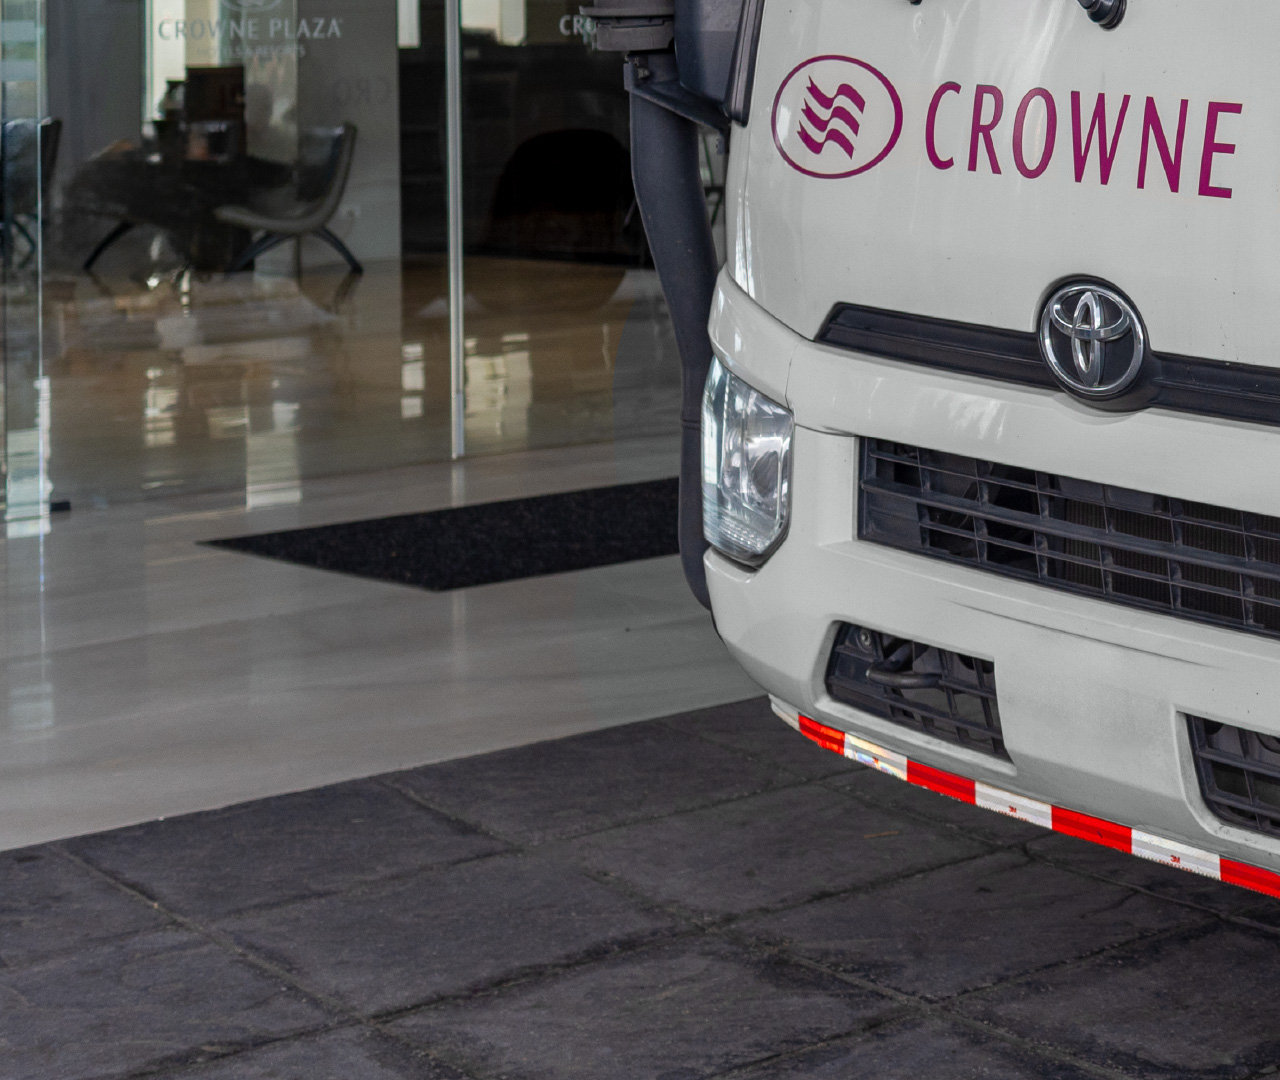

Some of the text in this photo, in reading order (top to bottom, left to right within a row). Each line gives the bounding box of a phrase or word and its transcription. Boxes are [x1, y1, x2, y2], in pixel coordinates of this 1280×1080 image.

[158, 16, 343, 41] CROWNE PLAZA
[925, 80, 1243, 199] CROWNE
